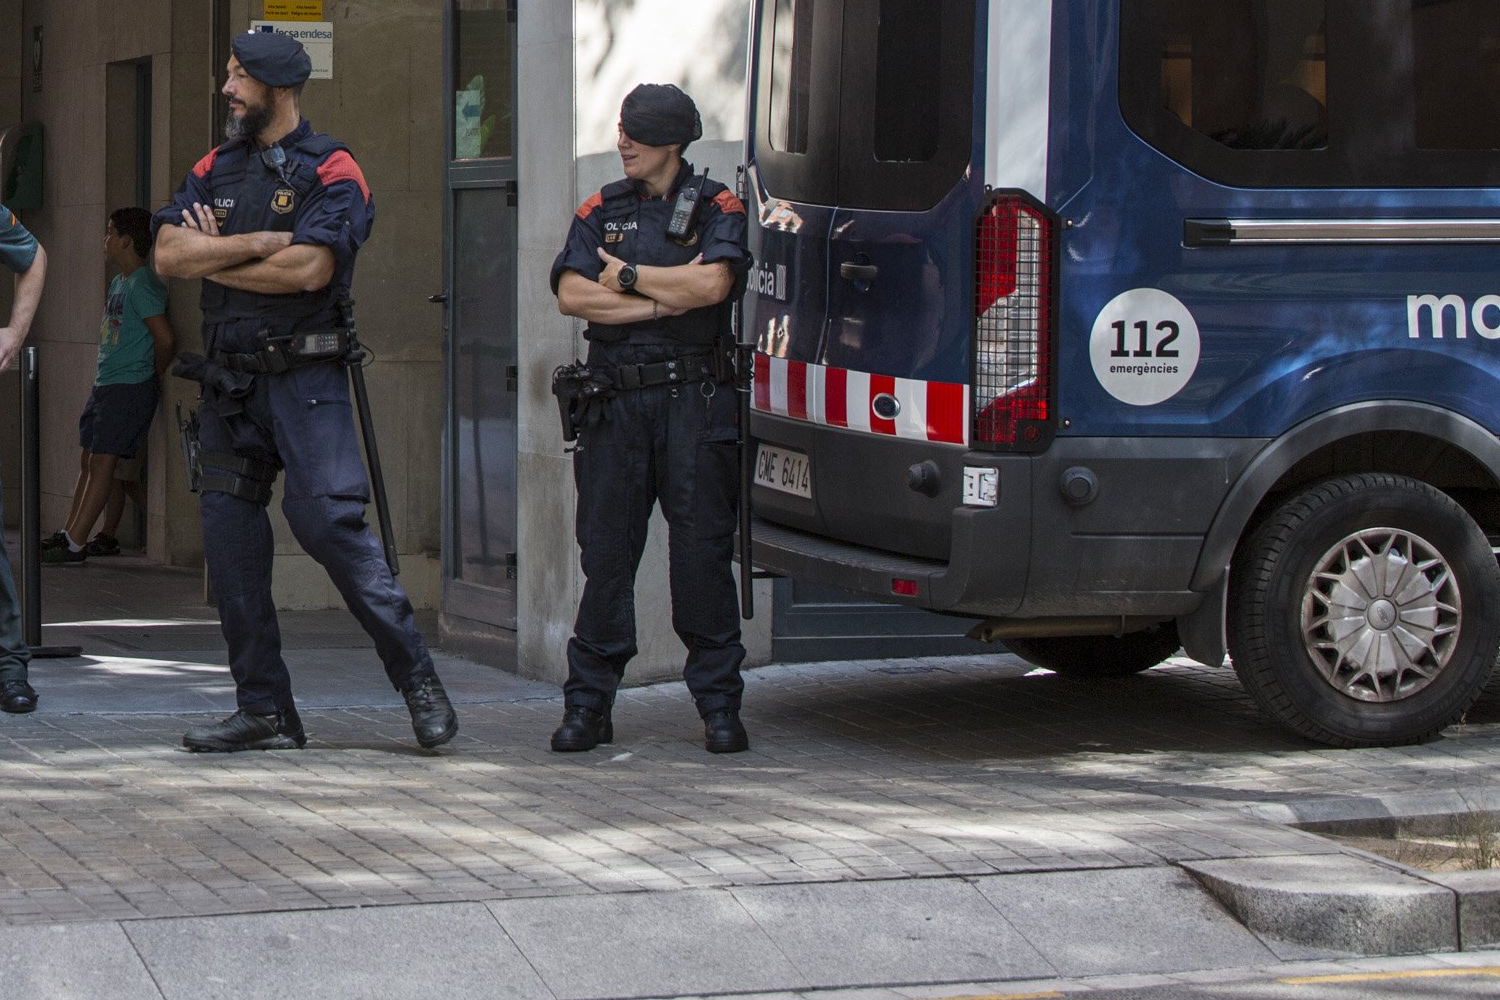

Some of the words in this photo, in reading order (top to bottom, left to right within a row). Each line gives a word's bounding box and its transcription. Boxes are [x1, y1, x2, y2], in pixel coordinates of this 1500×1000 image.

[300, 28, 333, 39] endesa
[747, 260, 775, 296] olicia
[1109, 320, 1180, 359] 112
[1109, 361, 1179, 376] emergències
[758, 449, 778, 483] CME
[781, 456, 809, 492] 6414
